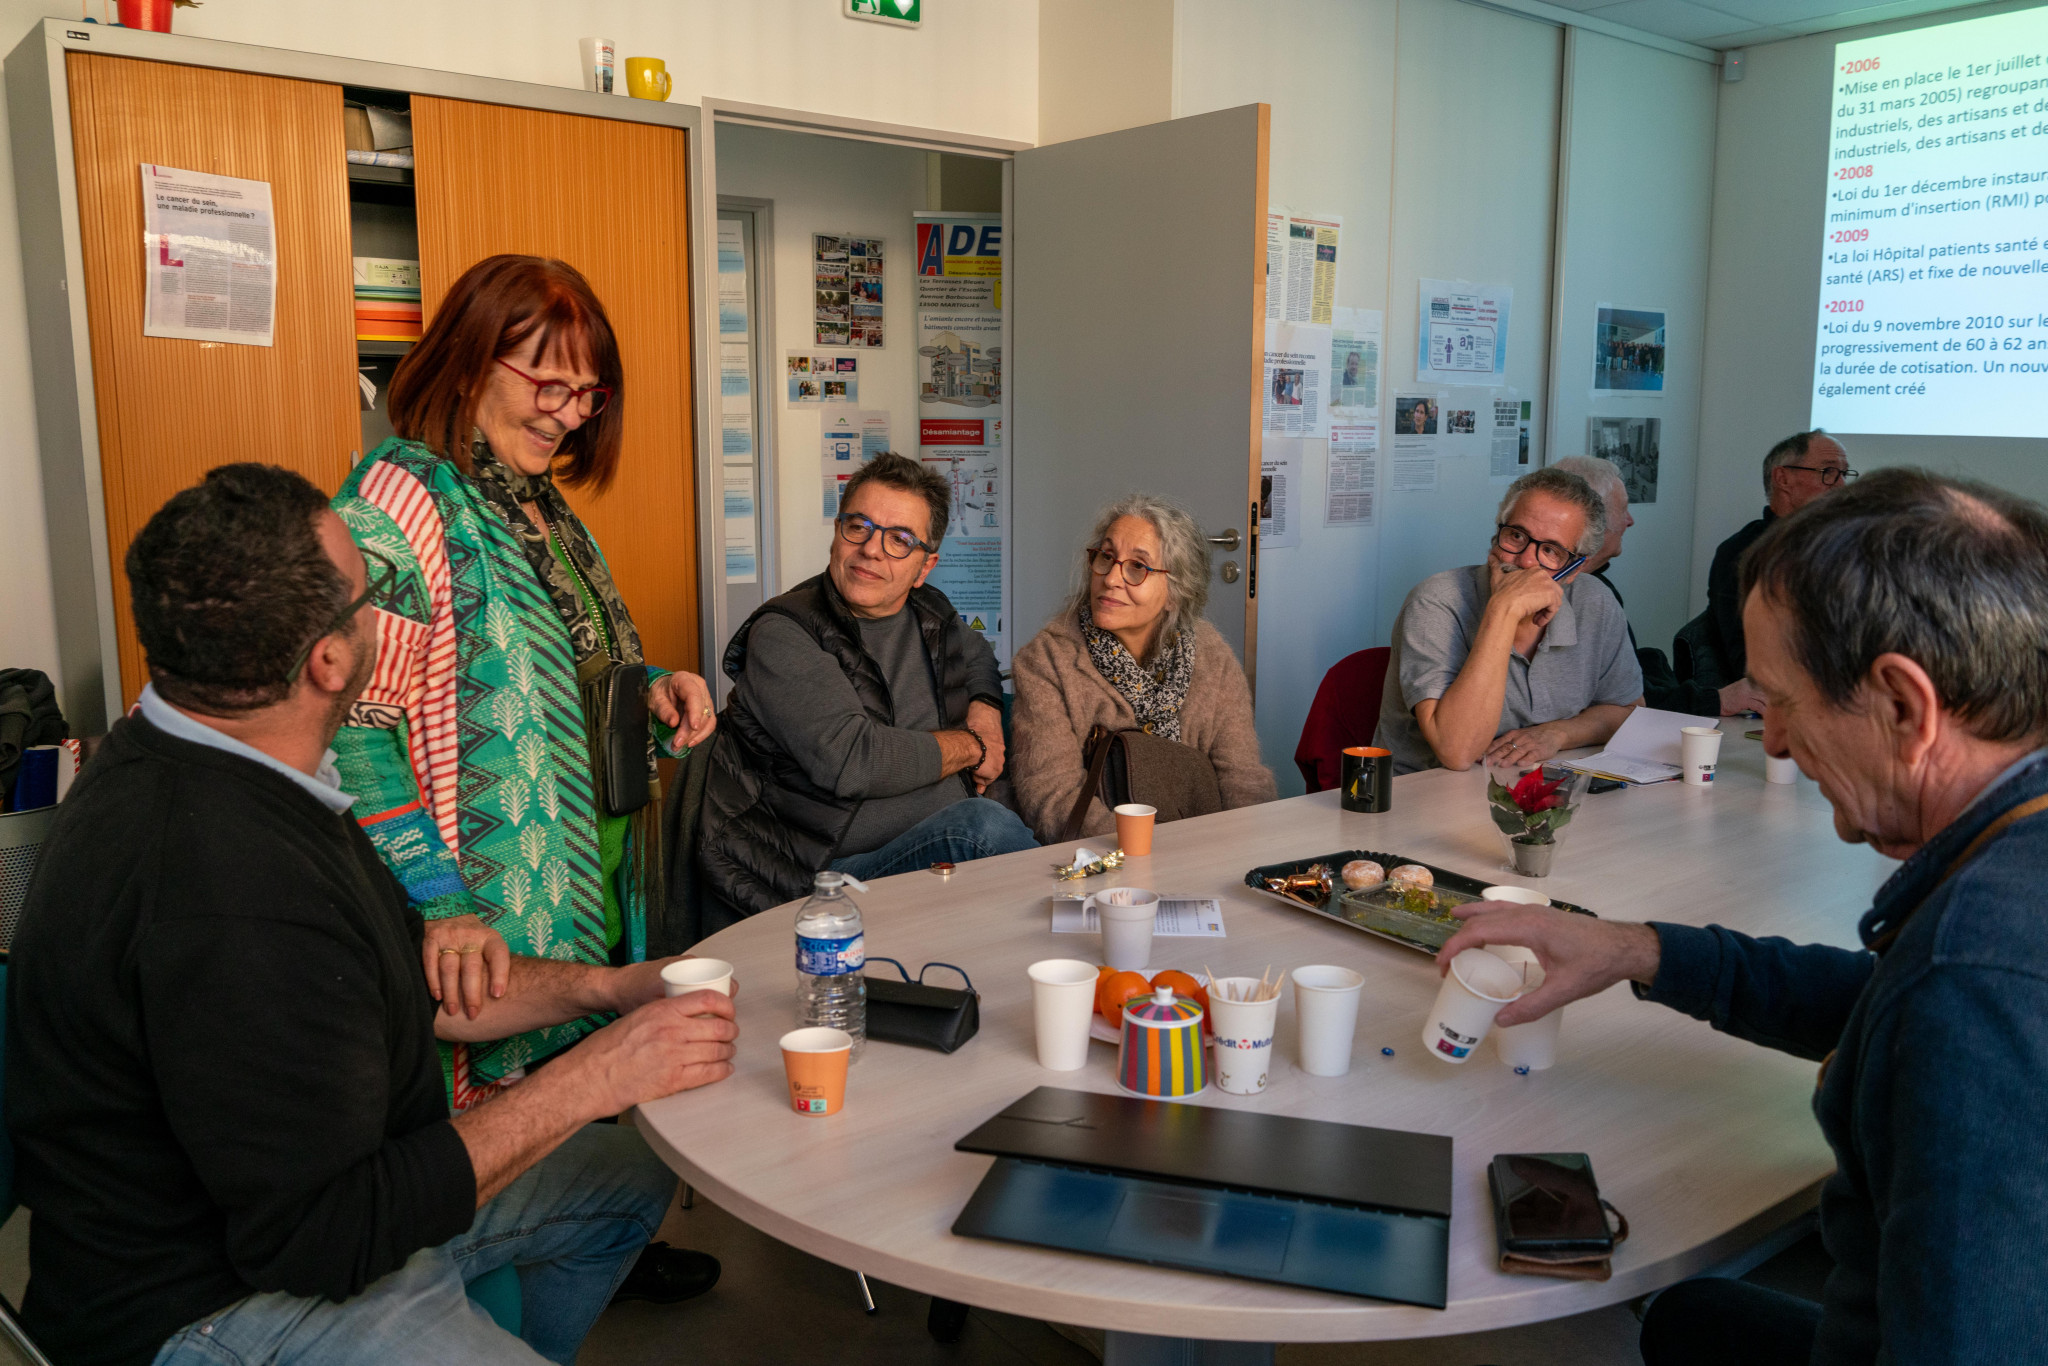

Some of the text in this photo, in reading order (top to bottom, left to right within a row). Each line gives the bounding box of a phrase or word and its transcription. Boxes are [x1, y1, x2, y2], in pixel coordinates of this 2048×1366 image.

[1845, 57, 1880, 74] 2006
[1845, 81, 1877, 96] Mise
[1882, 78, 1899, 89] en
[1905, 71, 1943, 88] place
[1948, 67, 1961, 80] le
[1967, 63, 1991, 77] 1er
[1995, 54, 2041, 75] juillet
[1837, 104, 1854, 117] du
[1859, 101, 1875, 114] 31
[1880, 97, 1915, 112] mars
[1920, 88, 1962, 106] 2005)
[1836, 116, 1912, 139] industriels,
[1918, 111, 1943, 128] des
[1948, 105, 2007, 123] artisans
[2013, 101, 2028, 114] et
[1835, 138, 1911, 160] industriels,
[1916, 133, 1941, 150] des
[1946, 127, 2006, 146] artisans
[2011, 124, 2026, 138] et
[1839, 165, 1873, 180] 2008
[1838, 188, 1857, 202] Loi
[1862, 185, 1879, 199] du
[1885, 183, 1907, 196] 1er
[1912, 174, 1987, 194] décembre
[167, 196, 189, 204] cancer
[202, 199, 218, 207] sein,
[172, 204, 198, 213] maladie
[1831, 208, 1896, 223] minimum
[1902, 197, 1980, 216] d'insertion
[1986, 192, 2029, 211] (RMI)
[1835, 229, 1869, 243] 2009
[1834, 251, 1847, 264] La
[1853, 249, 1869, 262] loi
[1873, 245, 1924, 263] Hôpital
[1929, 242, 1989, 259] patients
[1995, 237, 2038, 253] santé
[1826, 271, 1862, 285] santé
[1867, 268, 1904, 285] (ARS)
[1909, 268, 1923, 280] et
[1928, 266, 1953, 279] fixe
[1959, 264, 1977, 277] de
[1830, 300, 1864, 313] 2010
[1829, 321, 1848, 334] Loi
[1852, 319, 1869, 333] du
[1874, 320, 1881, 332] 9
[1887, 317, 1960, 331] novembre
[1966, 315, 2003, 329] 2010
[2008, 317, 2033, 328] sur
[1822, 340, 1938, 357] progressivement
[1943, 338, 1961, 352] de
[1966, 338, 1984, 351] 60
[1990, 338, 1998, 351] à
[2003, 337, 2022, 350] 62
[1820, 362, 1831, 375] la
[1835, 361, 1875, 375] durée
[1880, 361, 1896, 374] de
[1901, 361, 1978, 374] cotisation.
[1983, 361, 2004, 373] Un
[1818, 383, 1926, 398] également créé
